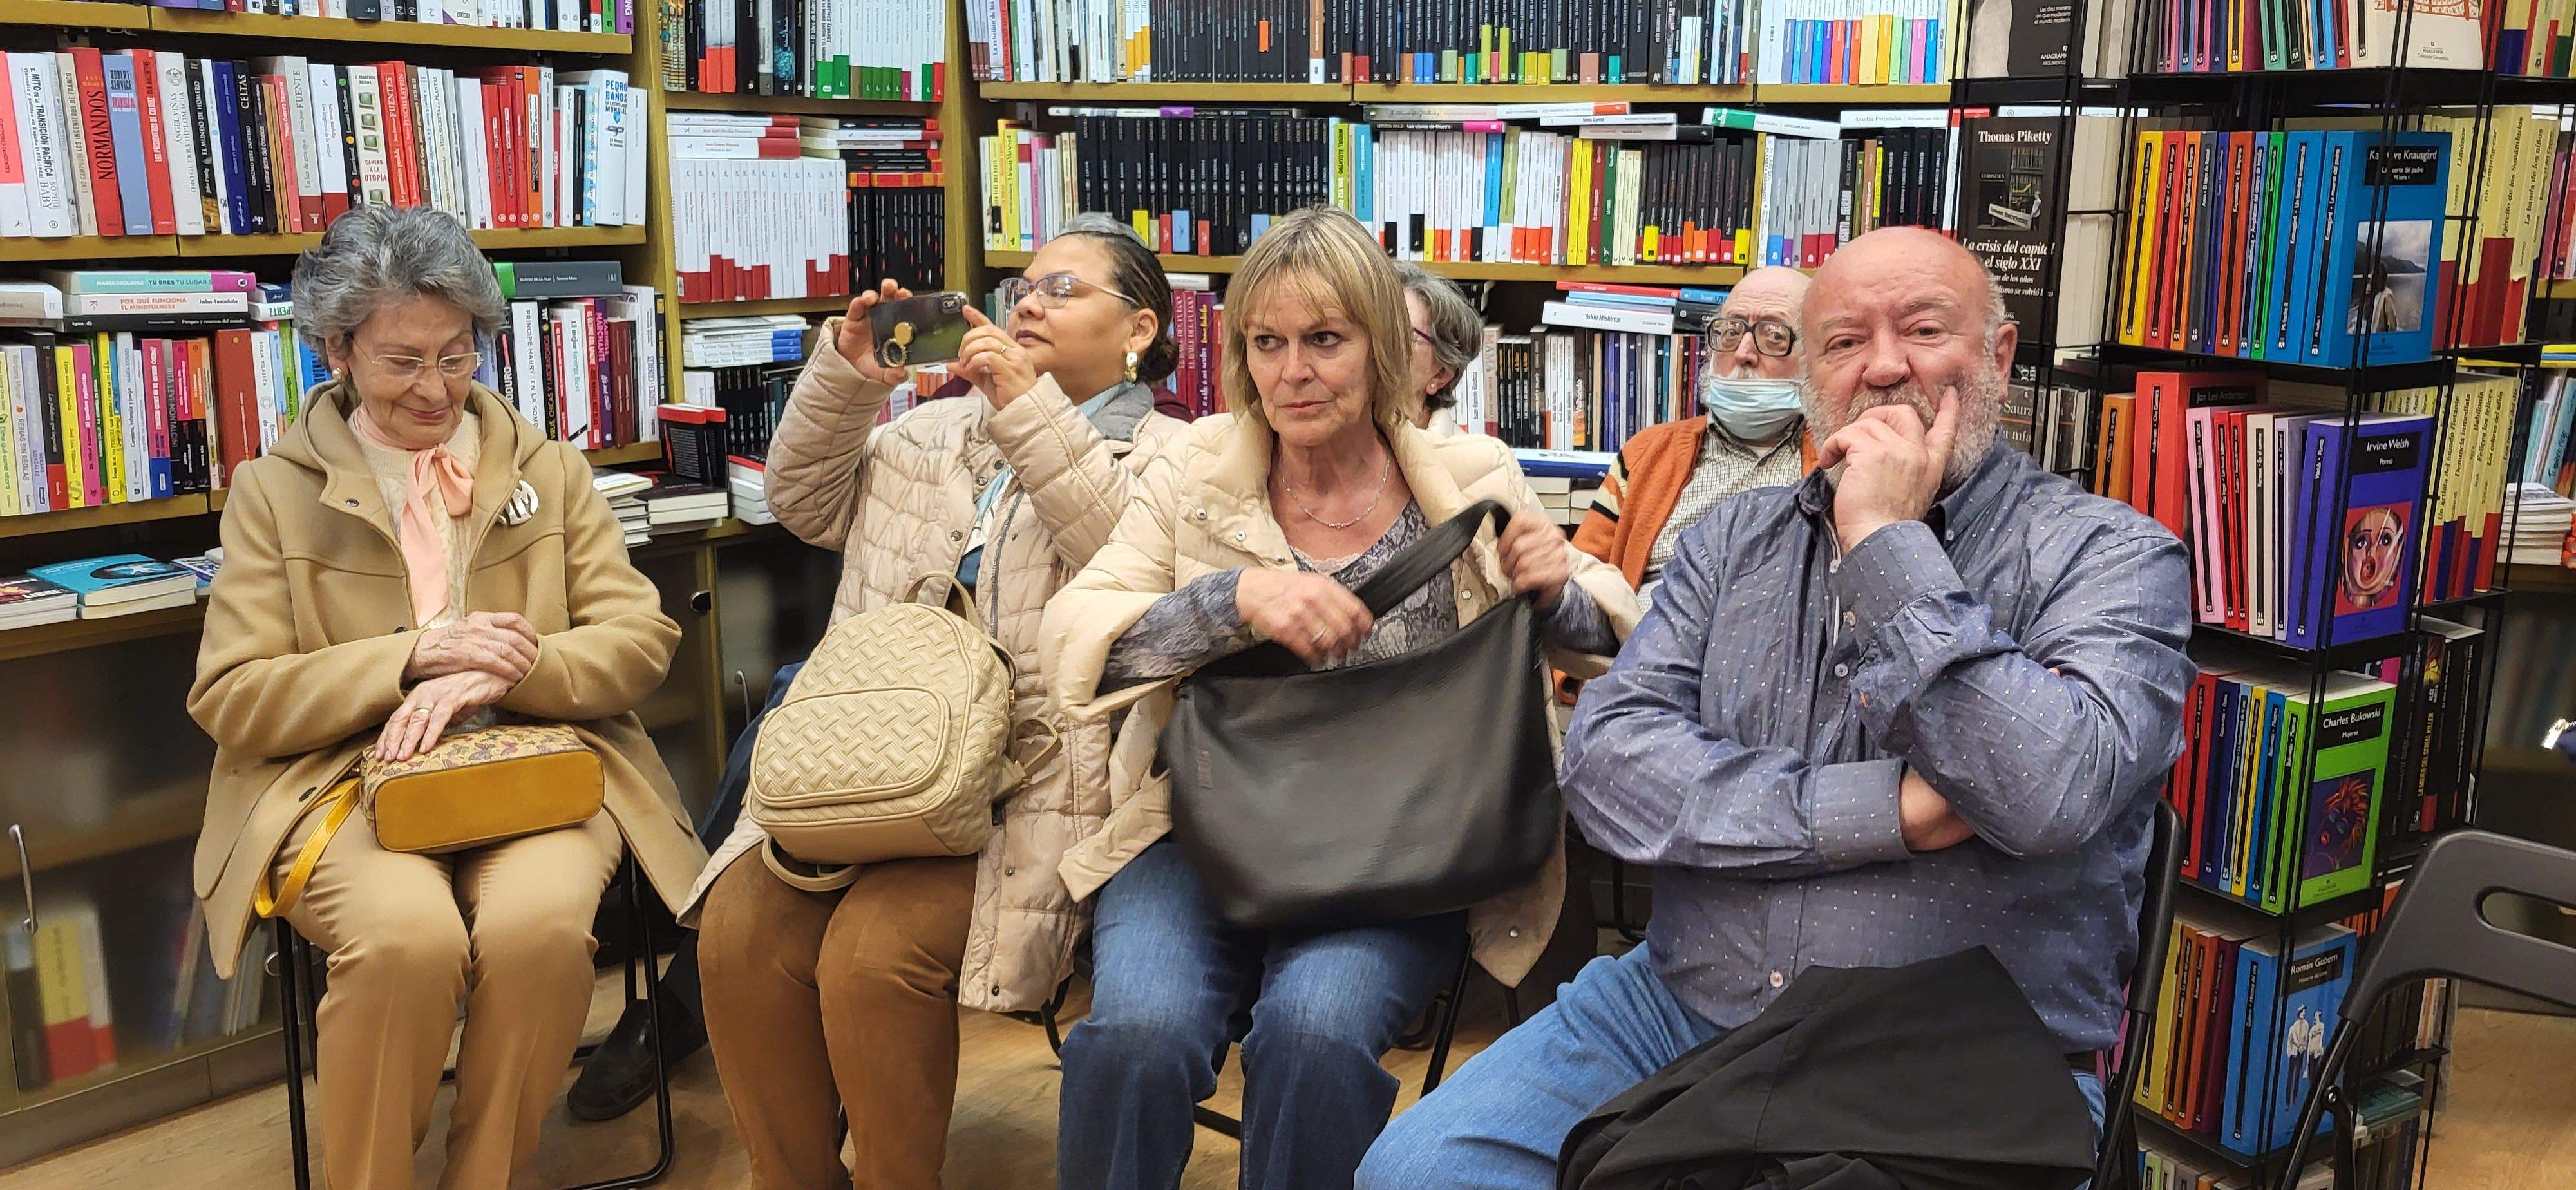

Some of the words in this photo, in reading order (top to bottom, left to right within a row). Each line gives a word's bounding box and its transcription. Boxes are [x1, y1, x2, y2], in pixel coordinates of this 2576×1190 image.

[32, 73, 41, 91] MITO
[109, 70, 129, 80] ROBERT
[111, 80, 132, 90] SERVICE
[238, 74, 250, 109] CELTAS
[292, 70, 305, 109] FUENTE
[605, 80, 628, 92] PEDRO
[193, 80, 202, 110] HOMERO
[386, 77, 397, 117] FUENTES
[605, 91, 628, 102] BAÑOS
[196, 111, 203, 120] DE
[605, 106, 627, 115] MUNDIAL
[35, 104, 50, 145] TRANSICIÓN
[198, 121, 207, 147] MUNDO
[88, 90, 115, 181] NORMANDOS
[1978, 131, 2015, 143] Thomas
[2017, 130, 2052, 144] Piketty
[2510, 117, 2524, 173] Sonámbulos
[2533, 129, 2543, 154] niños
[42, 145, 54, 177] PACÍFICA
[2403, 149, 2437, 162] Knausgård
[2485, 129, 2497, 191] camping-car
[365, 173, 386, 182] UTOPÍA
[2530, 171, 2537, 183] de
[40, 182, 53, 209] BABY
[2508, 189, 2514, 201] de
[2526, 185, 2535, 212] banda
[2524, 214, 2530, 226] La
[1977, 239, 2001, 252] crisis
[2003, 241, 2018, 254] del
[1985, 255, 1993, 268] el
[1995, 256, 2018, 272] siglo
[2019, 257, 2041, 271] XXI
[2010, 273, 2018, 283] los
[1598, 314, 1620, 323] Mishima
[596, 312, 605, 363] MARCHANTE
[530, 380, 536, 390] EN
[531, 392, 537, 403] LA
[2196, 391, 2206, 404] Jon
[2208, 392, 2219, 402] Lee
[2220, 391, 2248, 402] Anderson
[2483, 389, 2493, 416] felices
[167, 386, 178, 448] LEVI-MONTALCINI
[2003, 400, 2033, 416] Saura
[2450, 396, 2460, 430] flotante
[2459, 393, 2471, 436] inmediata
[2473, 391, 2484, 431] Babilonia
[2367, 442, 2387, 451] Irvine
[2389, 439, 2410, 449] Welsh
[2446, 431, 2454, 462] mundo
[2488, 424, 2498, 451] colores
[2379, 458, 2393, 466] Porno
[2455, 437, 2465, 477] Denuncia
[2439, 477, 2449, 509] artista
[2438, 509, 2443, 520] Un
[2322, 713, 2349, 729] Charles
[2350, 708, 2382, 722] Bukowski
[2342, 729, 2359, 739] Mujeres
[2290, 961, 2313, 976] Román
[2314, 953, 2338, 967] Gubern
